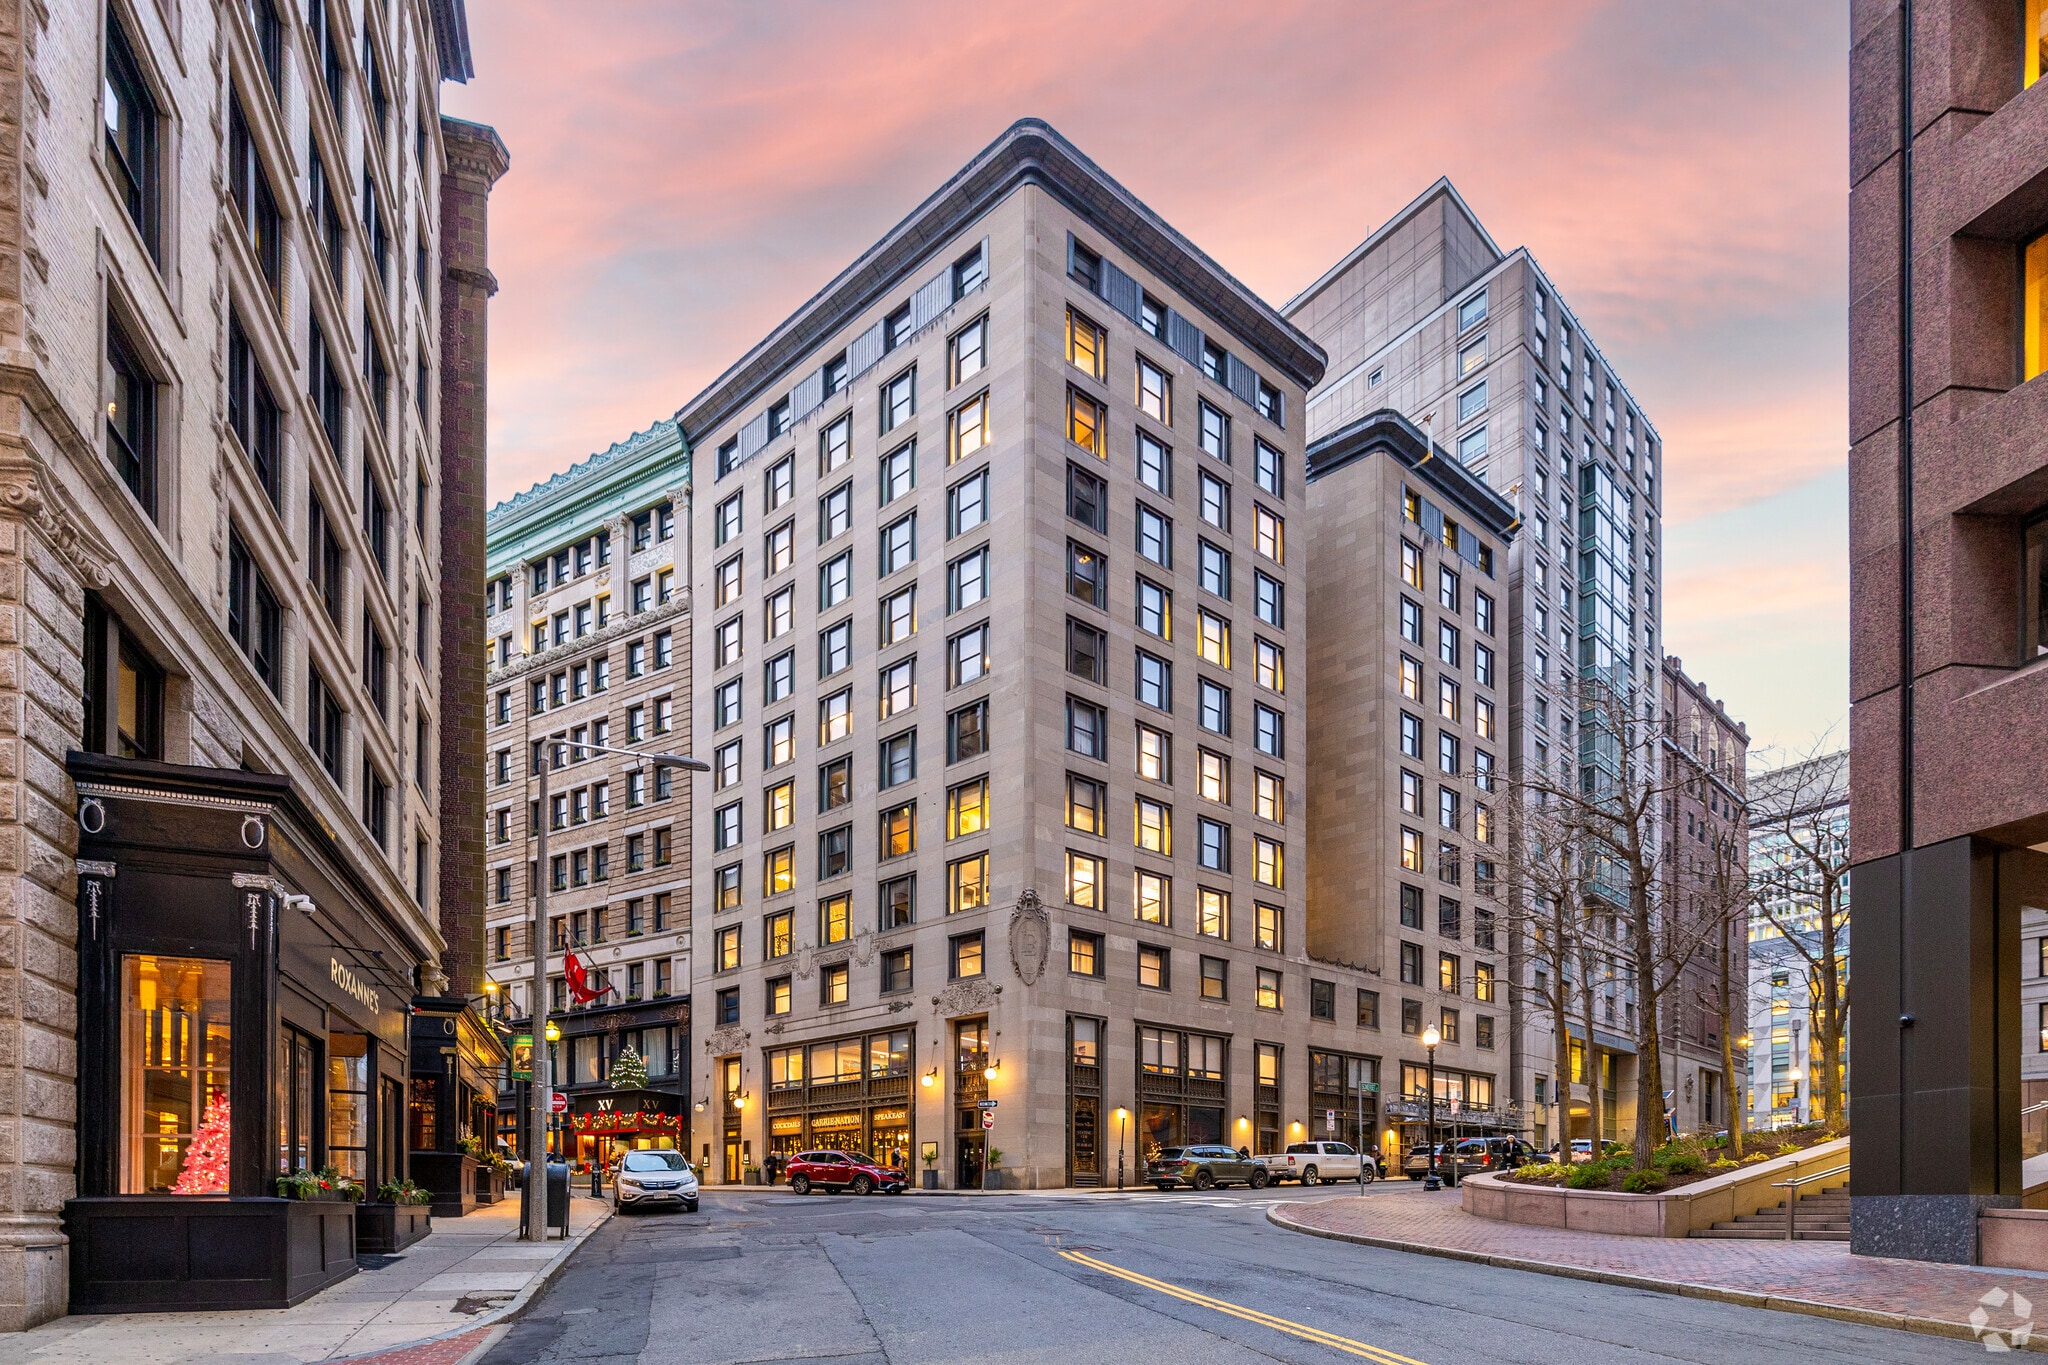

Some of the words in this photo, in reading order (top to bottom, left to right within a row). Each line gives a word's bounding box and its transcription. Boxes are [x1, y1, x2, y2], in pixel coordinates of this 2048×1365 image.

[331, 957, 379, 1015] ROXANNE'S
[598, 1099, 614, 1111] XV
[643, 1099, 660, 1110] XV
[836, 1115, 860, 1125] NATION
[874, 1111, 906, 1121] SPEAKEASY
[773, 1121, 801, 1130] COCKTAILS
